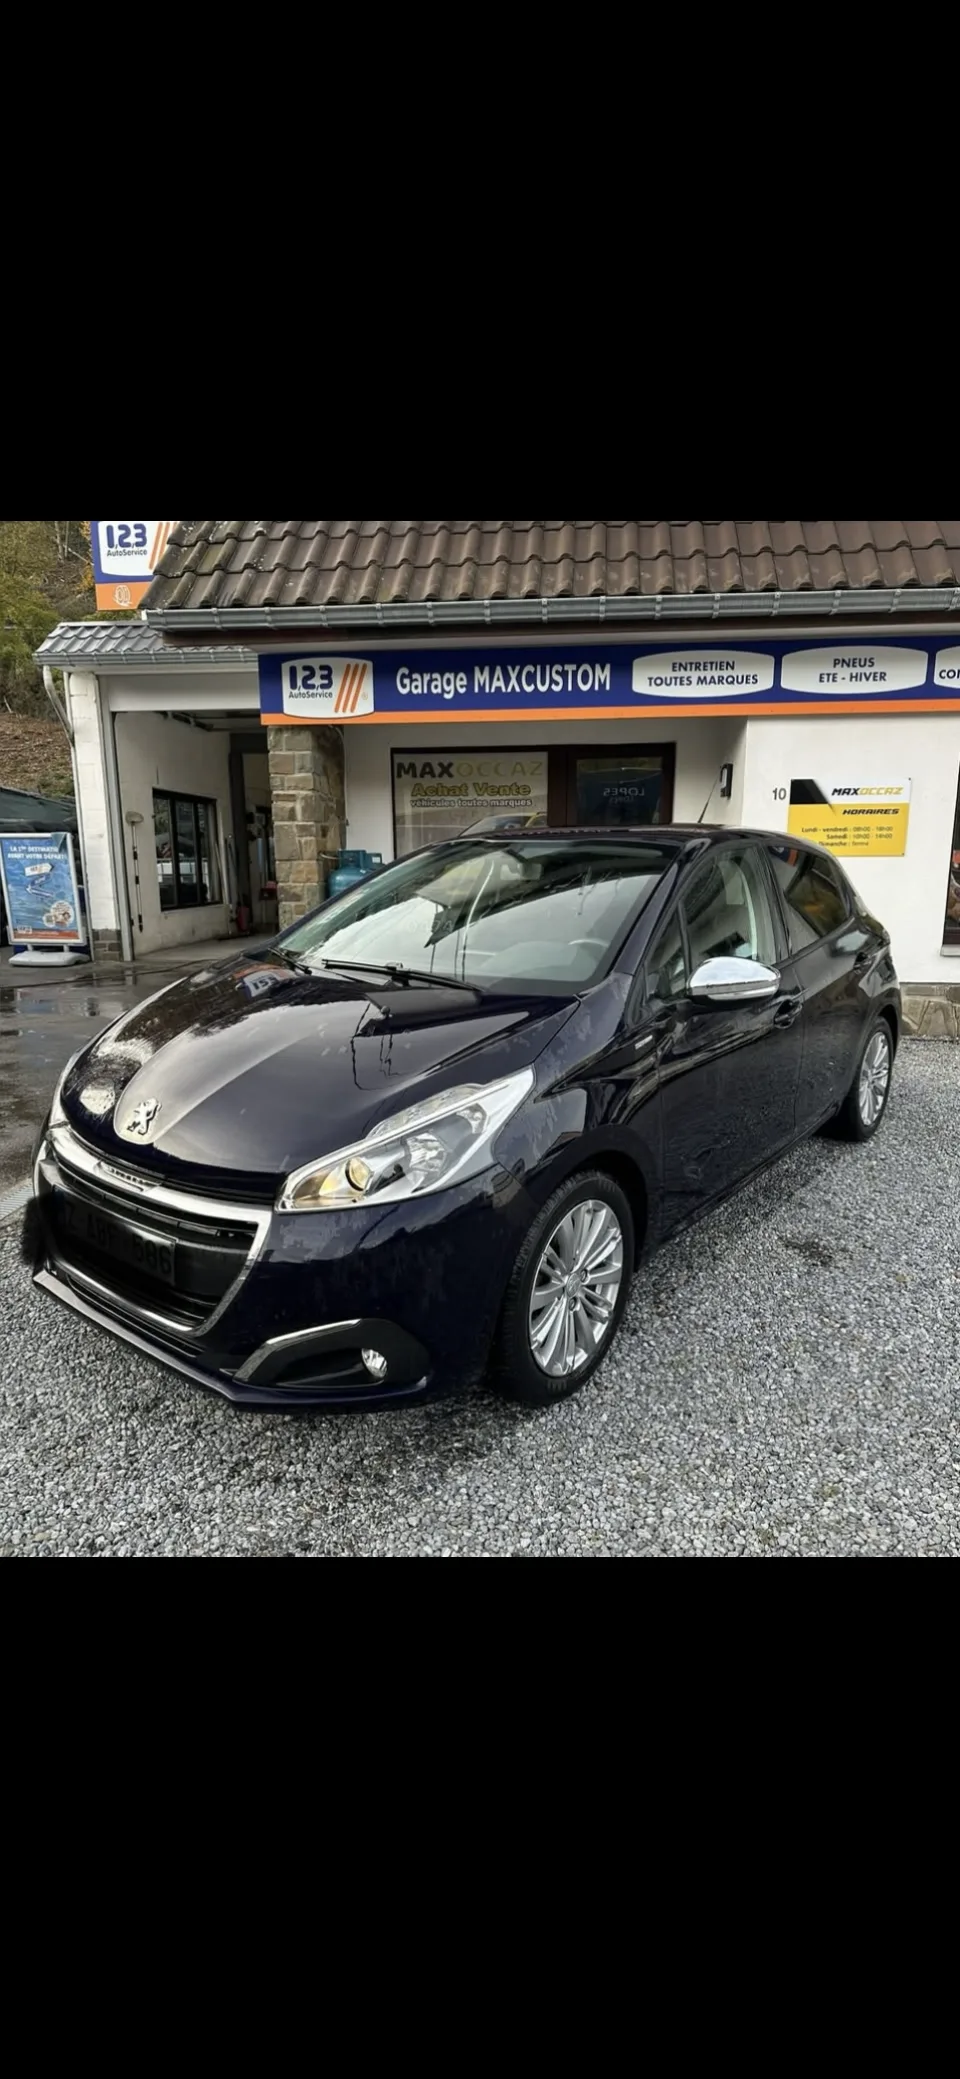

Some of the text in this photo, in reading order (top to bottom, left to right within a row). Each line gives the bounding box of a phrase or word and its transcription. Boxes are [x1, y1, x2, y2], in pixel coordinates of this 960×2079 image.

[107, 548, 148, 557] AutoService
[671, 661, 736, 672] ENTRETIEN
[833, 657, 875, 668] PNEUS
[396, 663, 611, 699] Garage MAXCUSTOM
[647, 674, 759, 687] TOUTES MARQUES
[818, 673, 838, 683] ETE
[849, 672, 887, 682] HIVER
[288, 691, 333, 699] AutoService
[396, 761, 543, 778] MAXOCCAZ
[411, 782, 532, 797] Achat Vente
[772, 787, 787, 801] 10
[831, 787, 903, 796] MAXOCCAZ
[457, 798, 489, 807] toutes
[490, 798, 533, 808] marques
